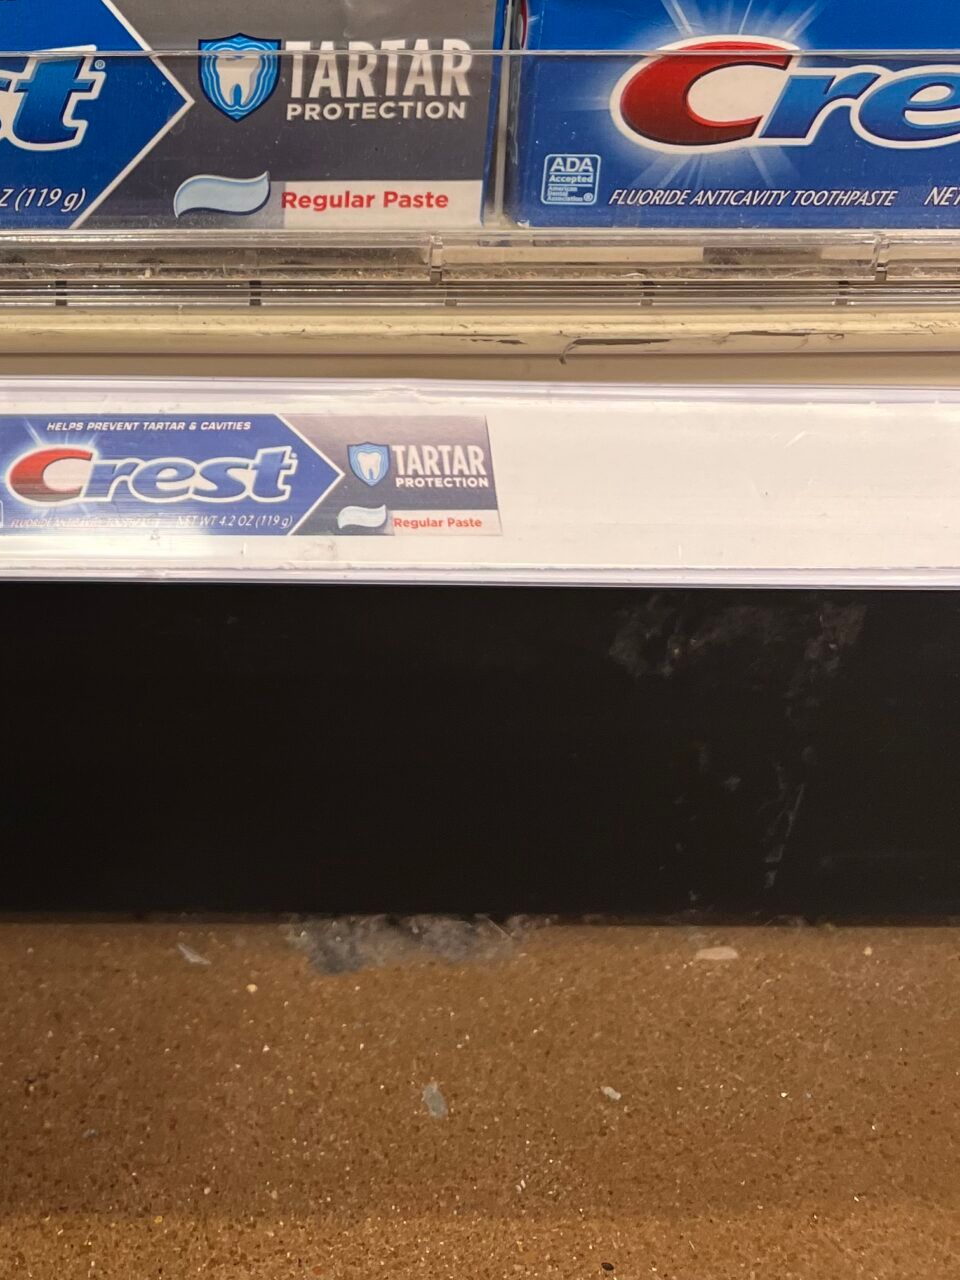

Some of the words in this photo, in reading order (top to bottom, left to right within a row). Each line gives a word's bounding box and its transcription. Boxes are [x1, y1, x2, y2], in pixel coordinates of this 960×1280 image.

[608, 188, 691, 207] FLUORIDE
[690, 188, 790, 207] ANTICAVITY
[789, 189, 899, 207] TOOTHPASTE
[47, 422, 84, 432] HELPS
[87, 422, 140, 432] PREVENT
[143, 422, 185, 431] TARTAR
[189, 422, 197, 431] &
[200, 421, 252, 431] CAVITIES
[392, 445, 487, 476] TARTAR
[5, 445, 298, 507] Crest
[395, 477, 489, 488] PROTECTION
[393, 517, 443, 529] Regular
[447, 517, 482, 528] Paste
